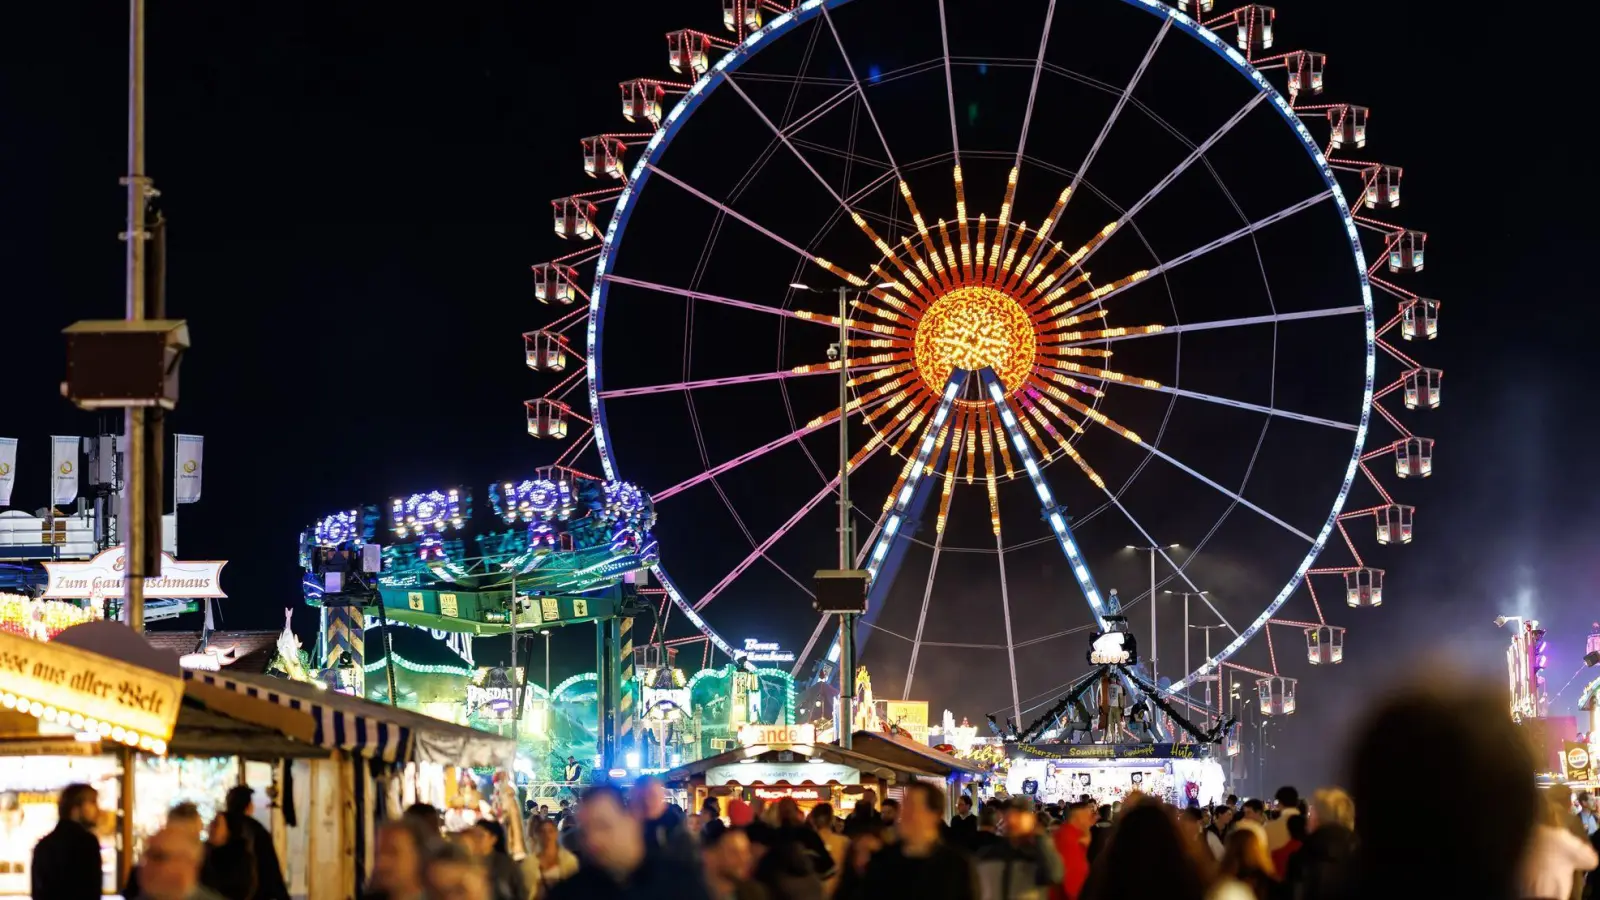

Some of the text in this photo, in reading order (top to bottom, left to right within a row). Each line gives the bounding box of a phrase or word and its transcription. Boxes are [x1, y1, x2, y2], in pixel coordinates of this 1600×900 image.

[55, 575, 210, 590] Zum Gaunschmaus
[32, 662, 66, 684] aus
[70, 670, 113, 698] aller
[118, 679, 163, 714] Welt
